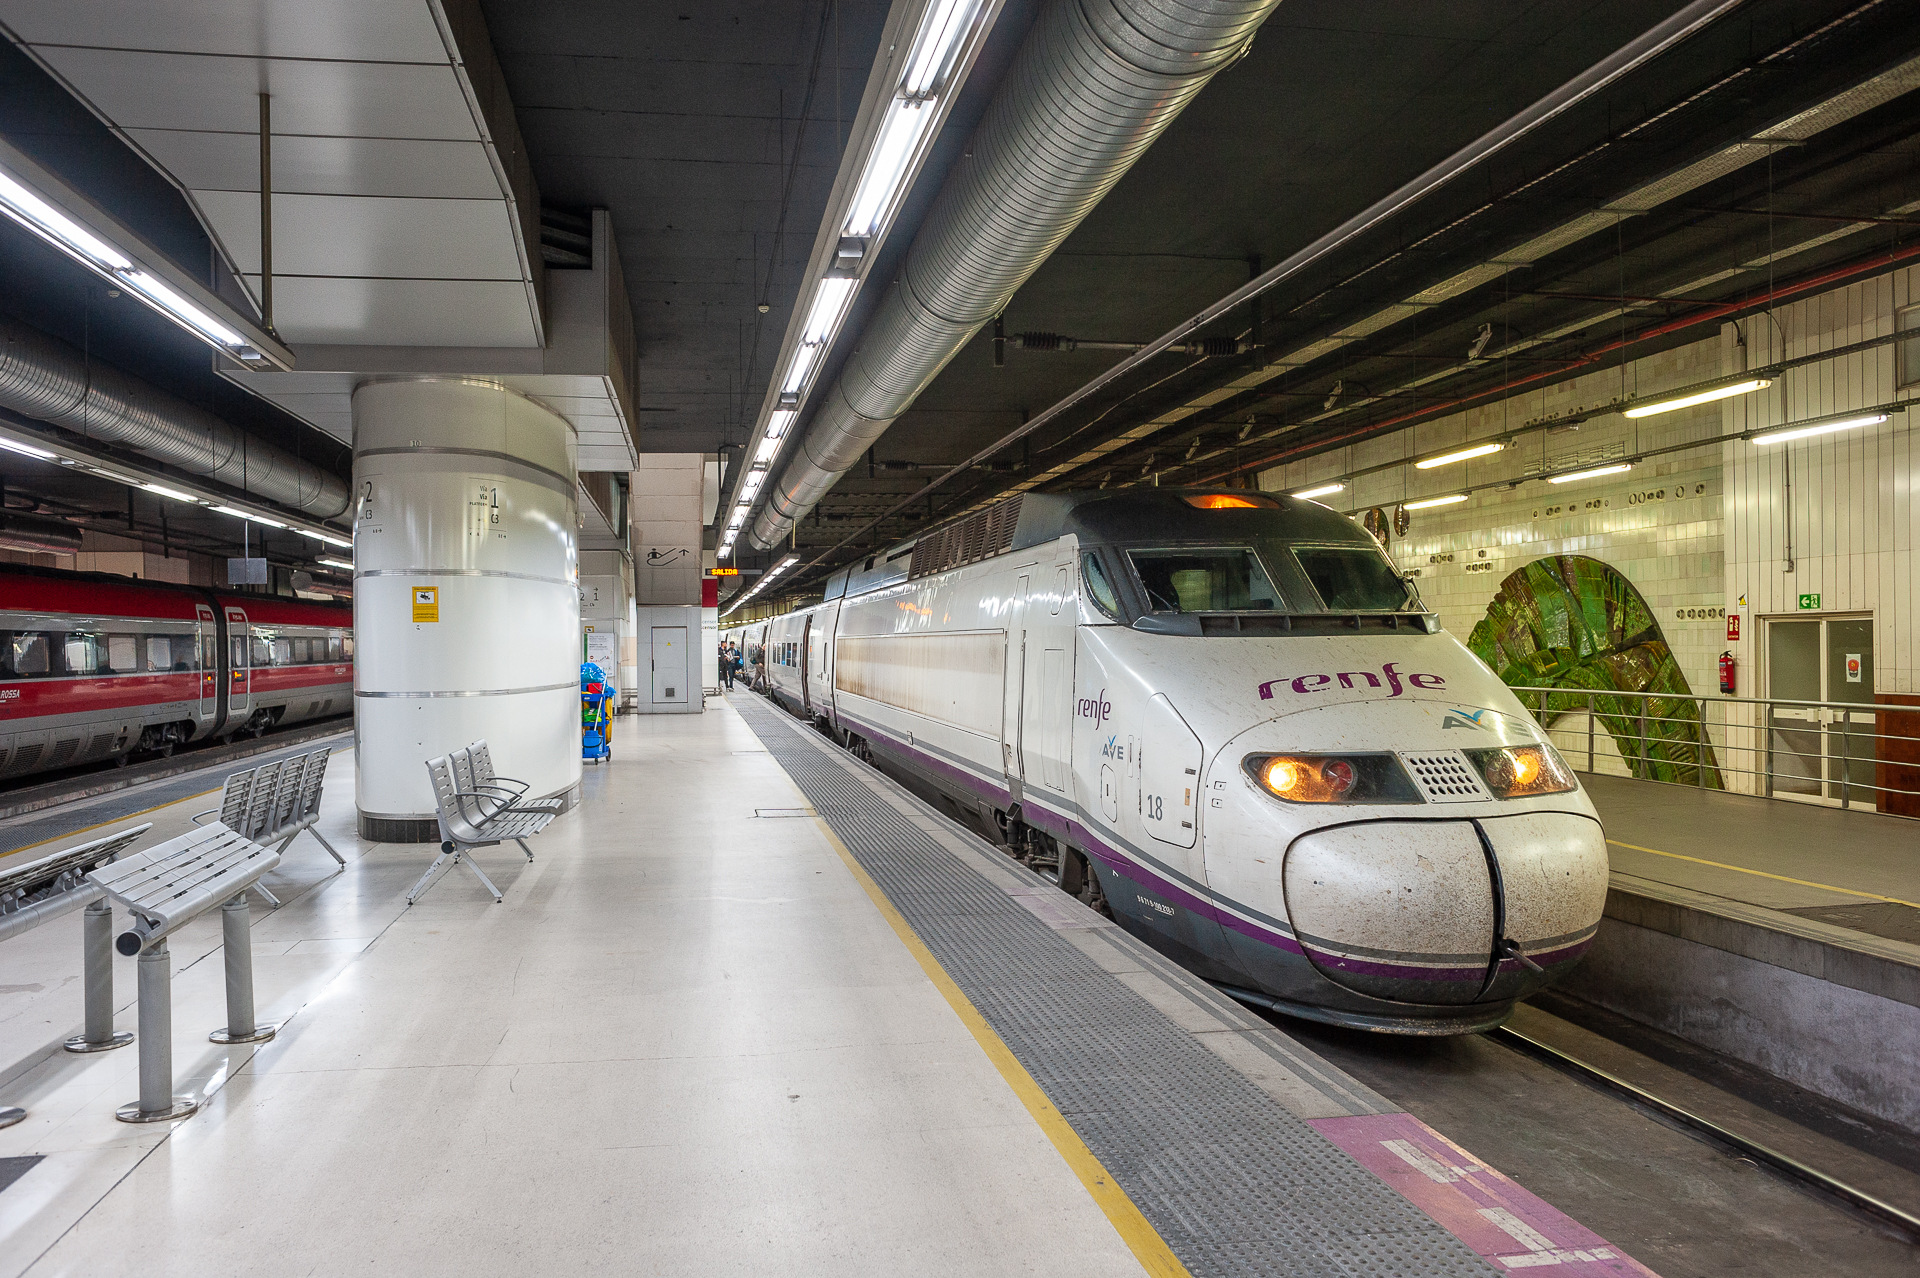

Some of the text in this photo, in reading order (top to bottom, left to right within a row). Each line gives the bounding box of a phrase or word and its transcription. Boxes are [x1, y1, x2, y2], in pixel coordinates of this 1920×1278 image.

[365, 481, 373, 503] 2
[491, 487, 499, 509] 1
[711, 568, 738, 576] SALIDA
[1258, 662, 1447, 700] renfe
[0, 689, 20, 699] ROSSA
[1077, 688, 1111, 731] renfe
[1101, 740, 1124, 761] AVE
[1147, 794, 1163, 821] 18
